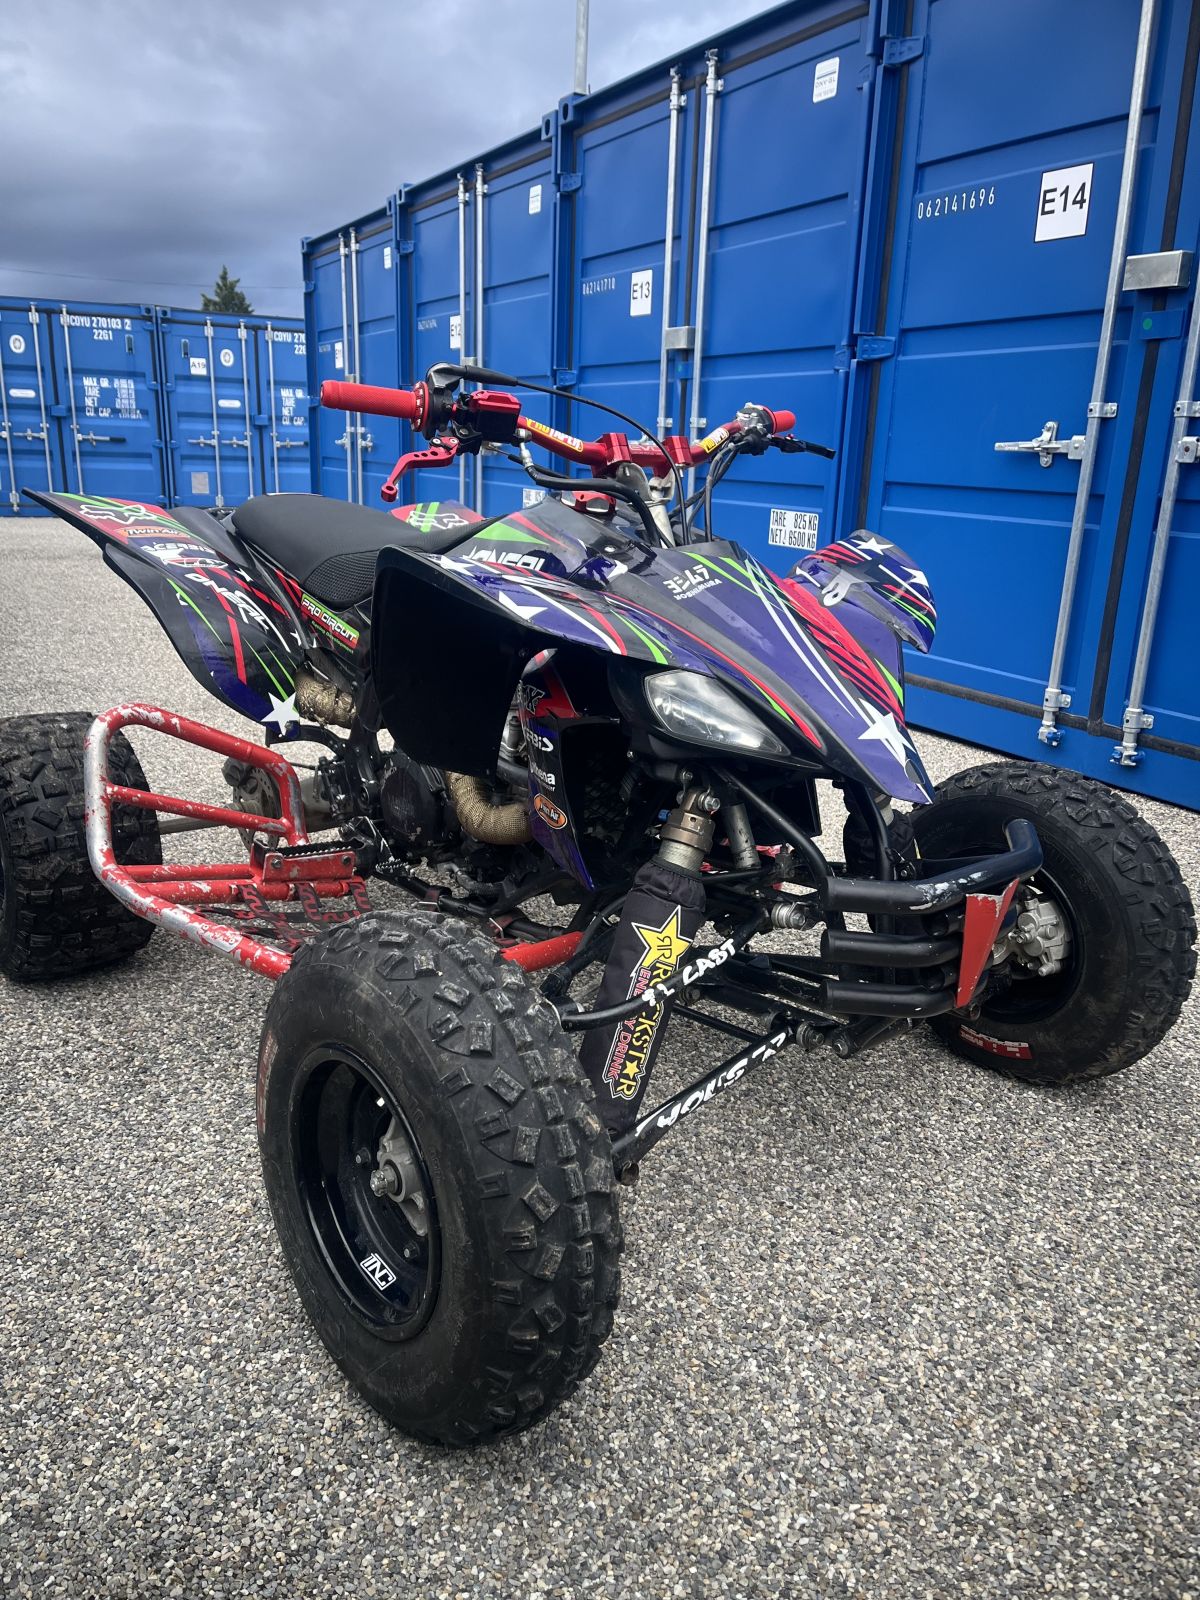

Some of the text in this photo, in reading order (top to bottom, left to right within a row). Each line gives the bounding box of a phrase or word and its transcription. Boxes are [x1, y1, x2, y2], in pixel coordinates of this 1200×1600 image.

[917, 187, 995, 220] 062141696
[1040, 182, 1087, 216] E14
[632, 281, 651, 300] E13
[70, 315, 90, 328] COYU
[92, 317, 122, 329] 270103
[93, 329, 113, 341] 22G1
[273, 331, 292, 343] COYU
[772, 511, 818, 531] TARE 825 KG
[788, 530, 806, 547] 6500
[807, 533, 816, 549] KG
[302, 598, 357, 642] PRO CIRCUIT
[682, 938, 736, 986] CAST
[607, 1030, 633, 1082] DRINK
